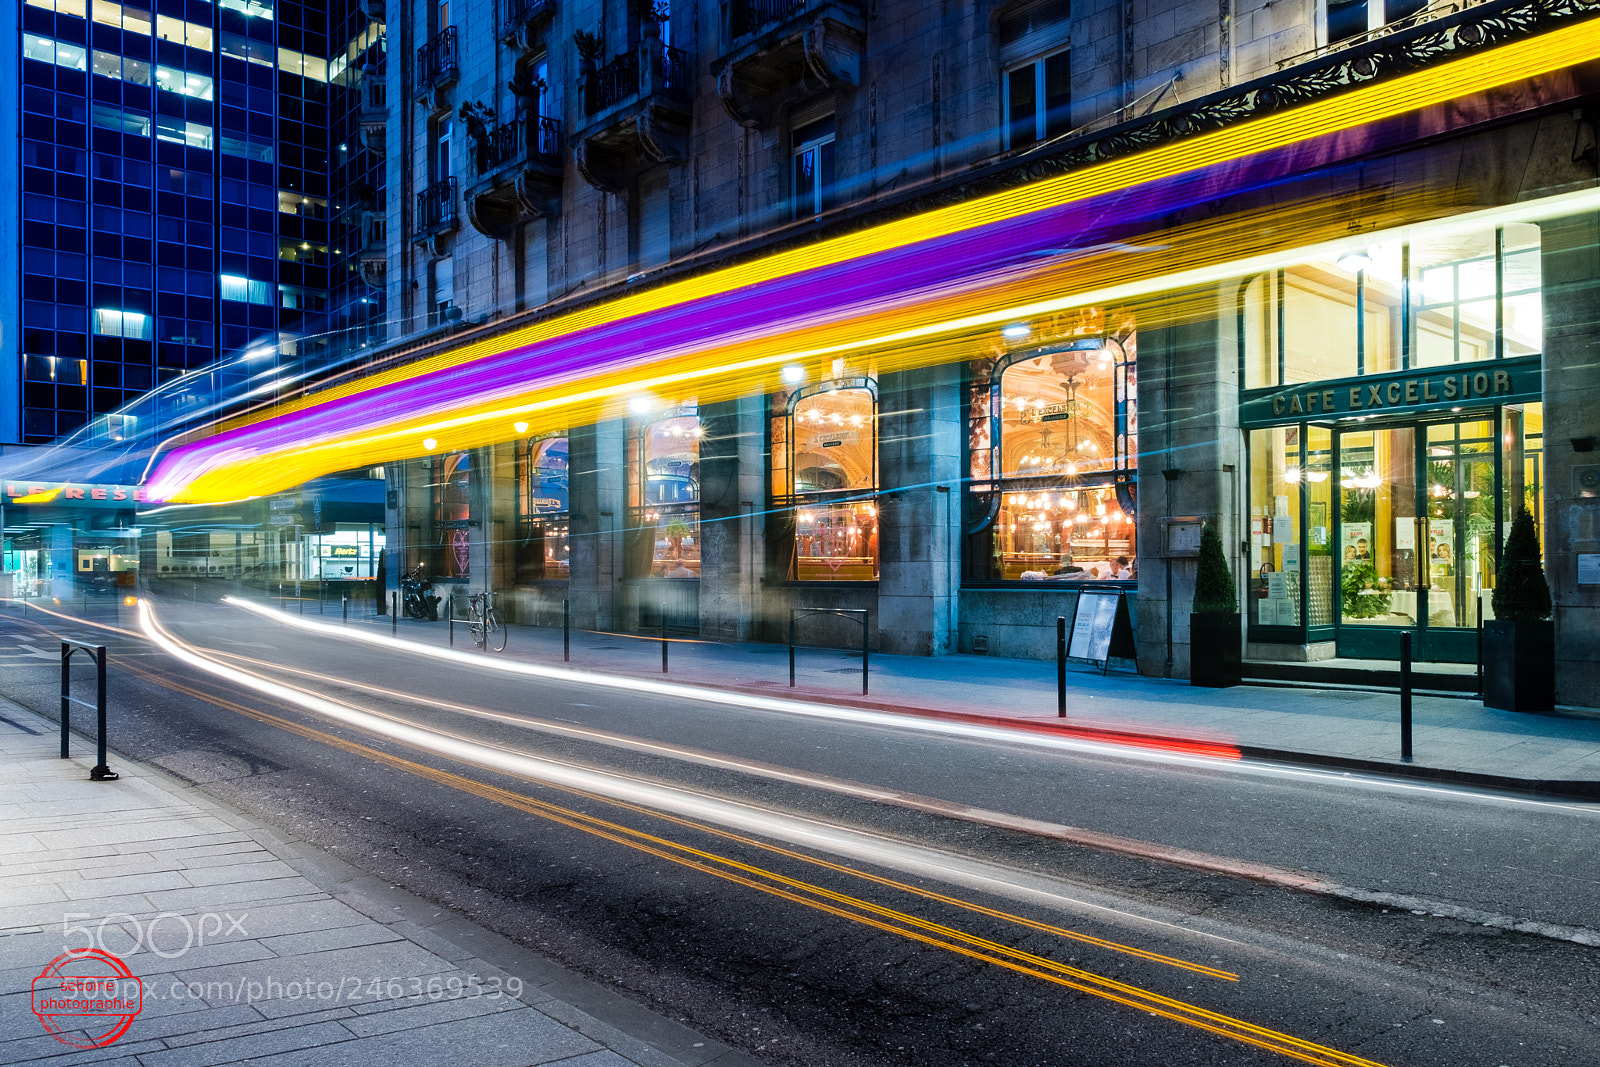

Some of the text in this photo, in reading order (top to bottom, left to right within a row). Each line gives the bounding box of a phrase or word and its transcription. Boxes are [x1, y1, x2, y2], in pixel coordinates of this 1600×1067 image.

[1272, 370, 1511, 416] CAFE EXCELSIOR
[7, 485, 46, 497] LE
[334, 547, 359, 556] Hertz
